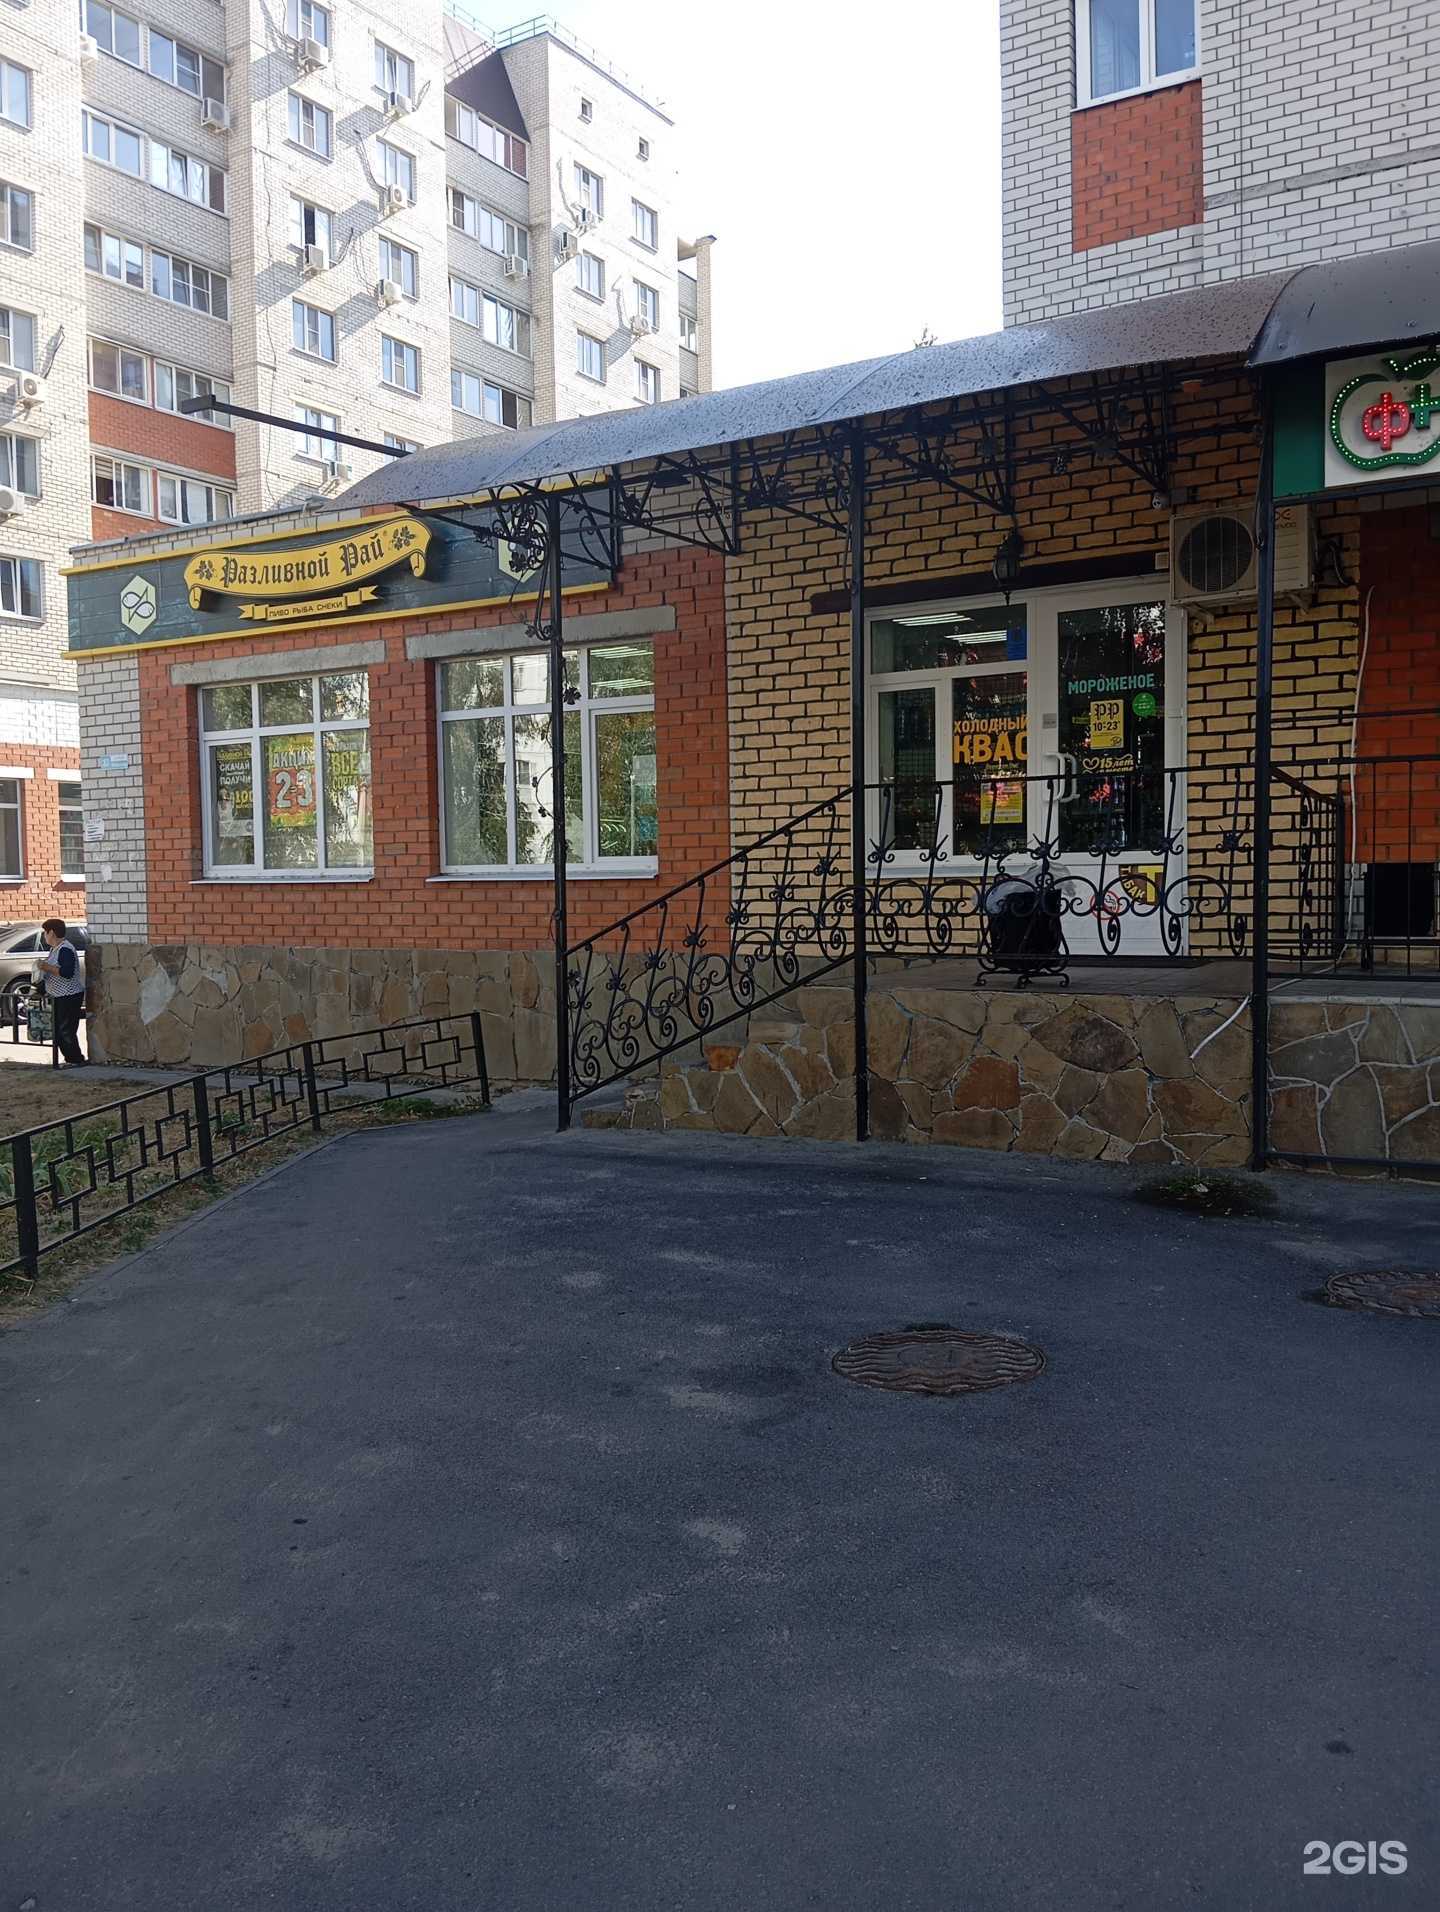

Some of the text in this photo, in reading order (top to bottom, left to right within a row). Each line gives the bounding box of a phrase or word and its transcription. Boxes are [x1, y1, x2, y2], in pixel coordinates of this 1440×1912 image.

[219, 532, 384, 588] Разливной Рай
[269, 600, 343, 617] ПИВО РЫБА СНЕКИ
[1067, 673, 1155, 695] МОРОЖЕНОЕ
[953, 714, 1029, 735] ХОЛОДНЫЙ
[952, 731, 1029, 765] КВАС
[219, 760, 250, 772] СКАЧАЙ
